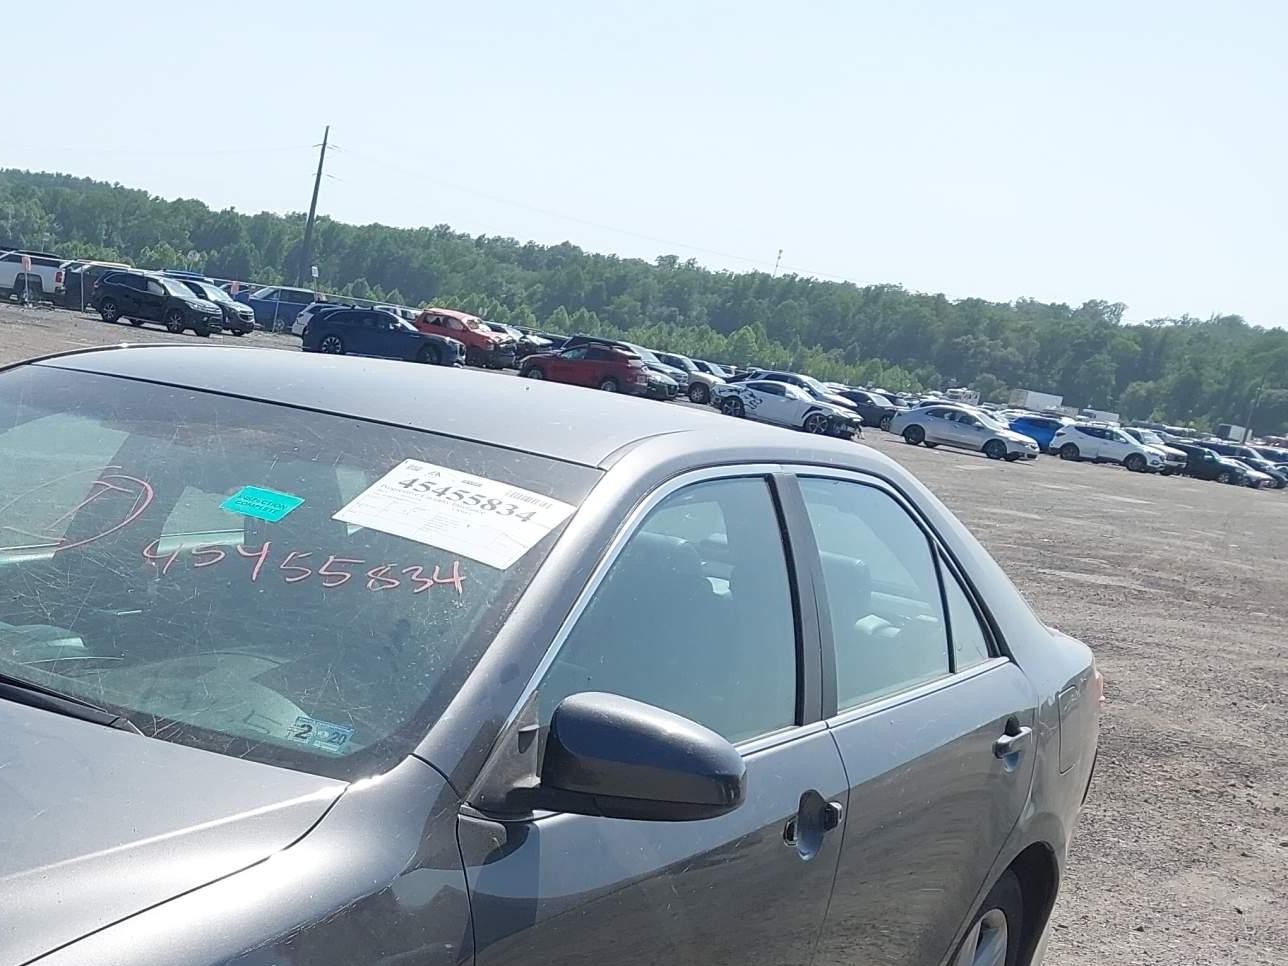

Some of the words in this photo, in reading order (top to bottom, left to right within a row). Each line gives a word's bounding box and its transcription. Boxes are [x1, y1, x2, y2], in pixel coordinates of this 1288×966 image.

[398, 477, 537, 523] 45455834
[143, 540, 467, 594] 45455834
[294, 723, 313, 740] 2
